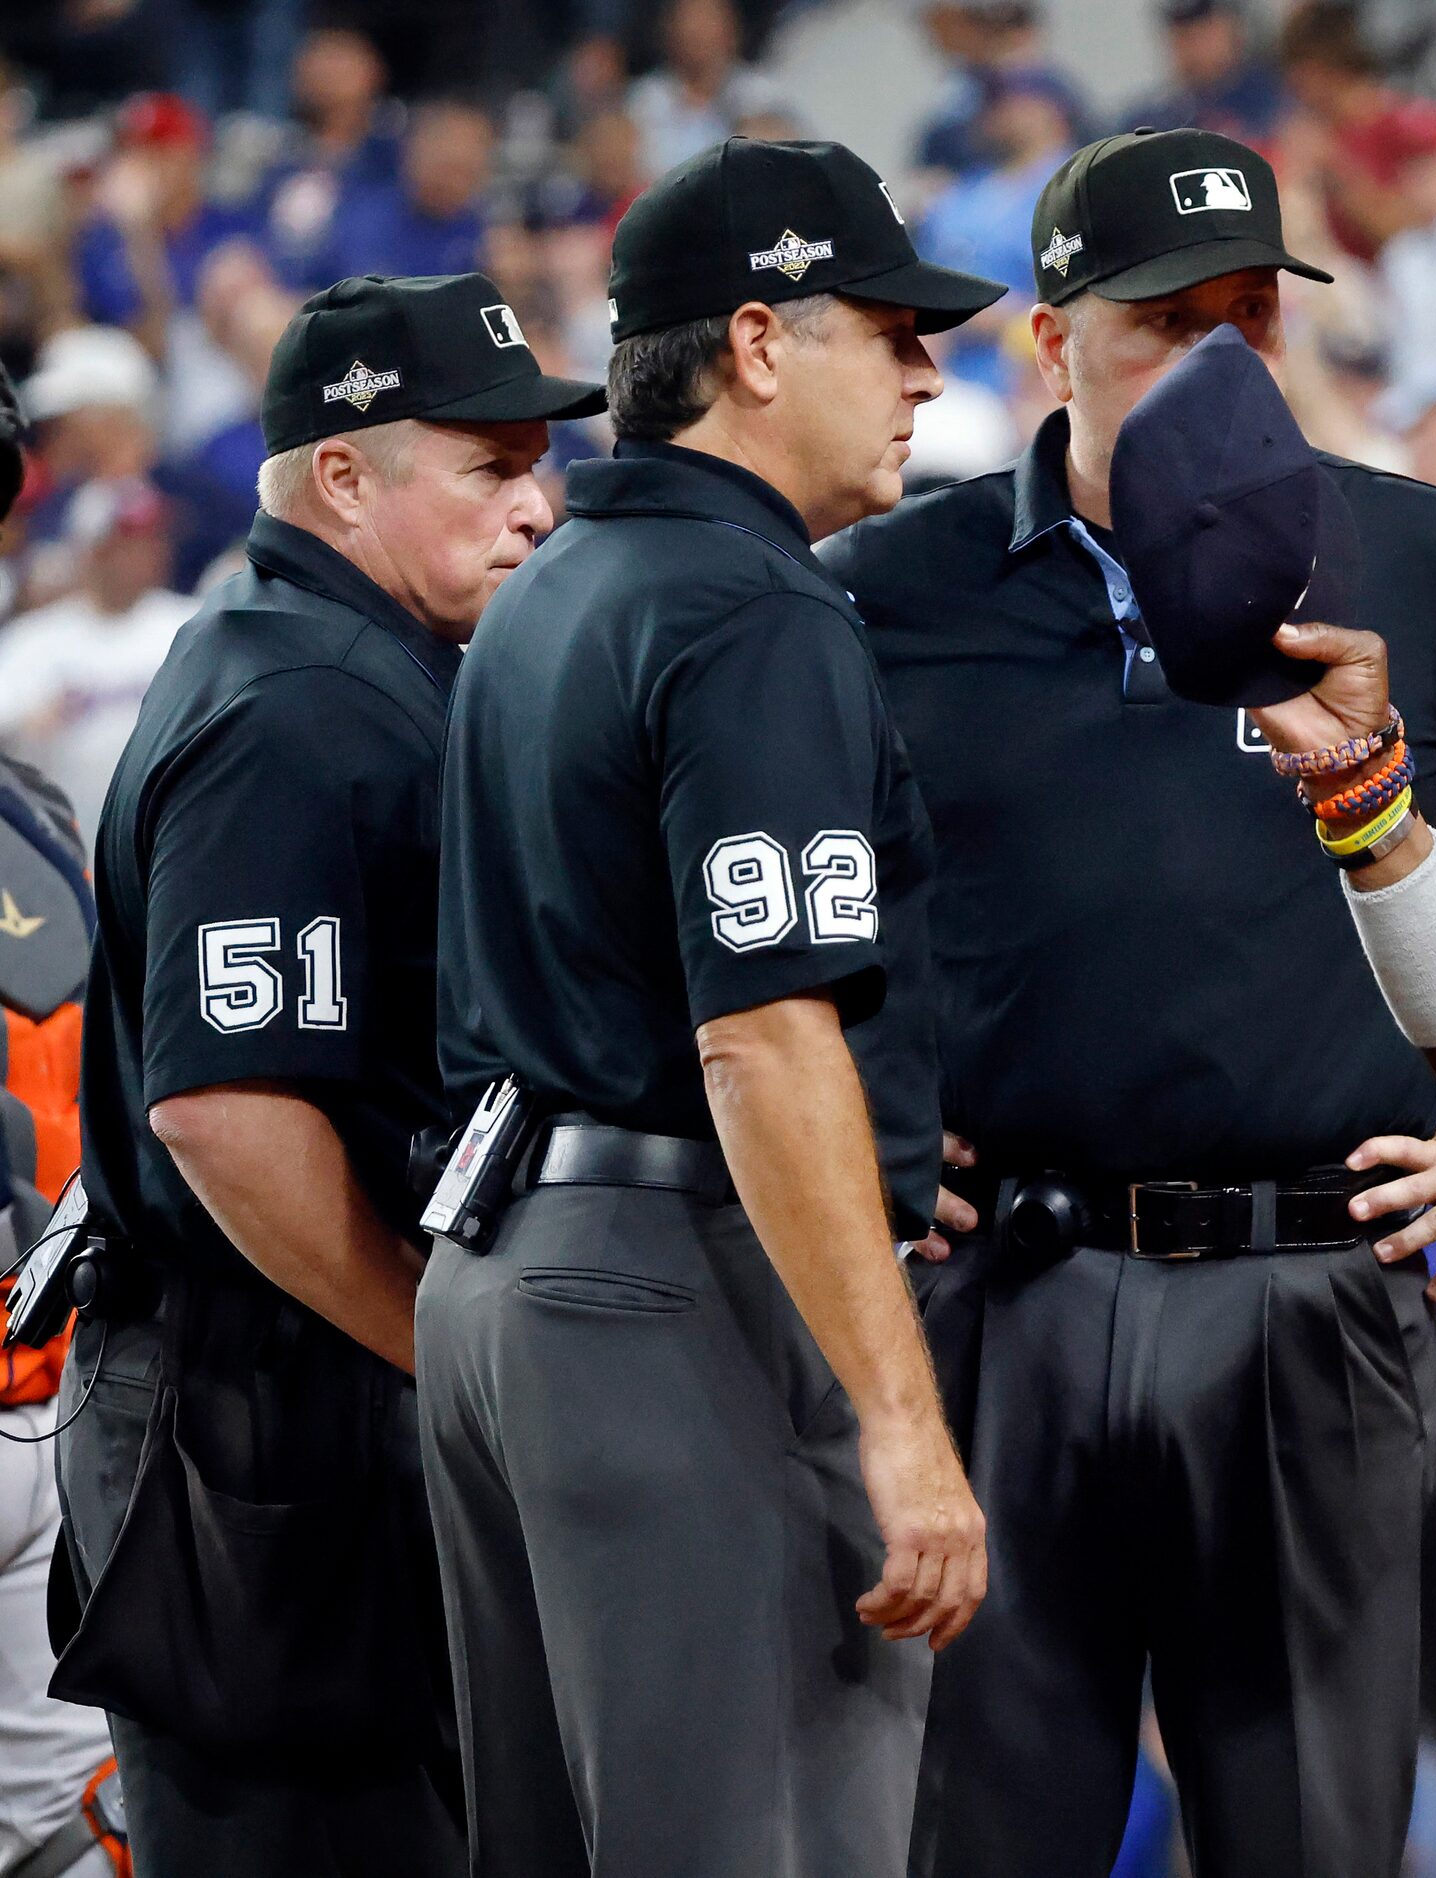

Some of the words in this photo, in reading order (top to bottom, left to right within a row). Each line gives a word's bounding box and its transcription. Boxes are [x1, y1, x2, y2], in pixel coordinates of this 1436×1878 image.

[750, 243, 833, 269] POSTSEASON
[784, 261, 805, 272] 2023
[323, 372, 400, 400] POSTSEASON
[702, 829, 879, 953] 92
[198, 916, 347, 1034] 51
